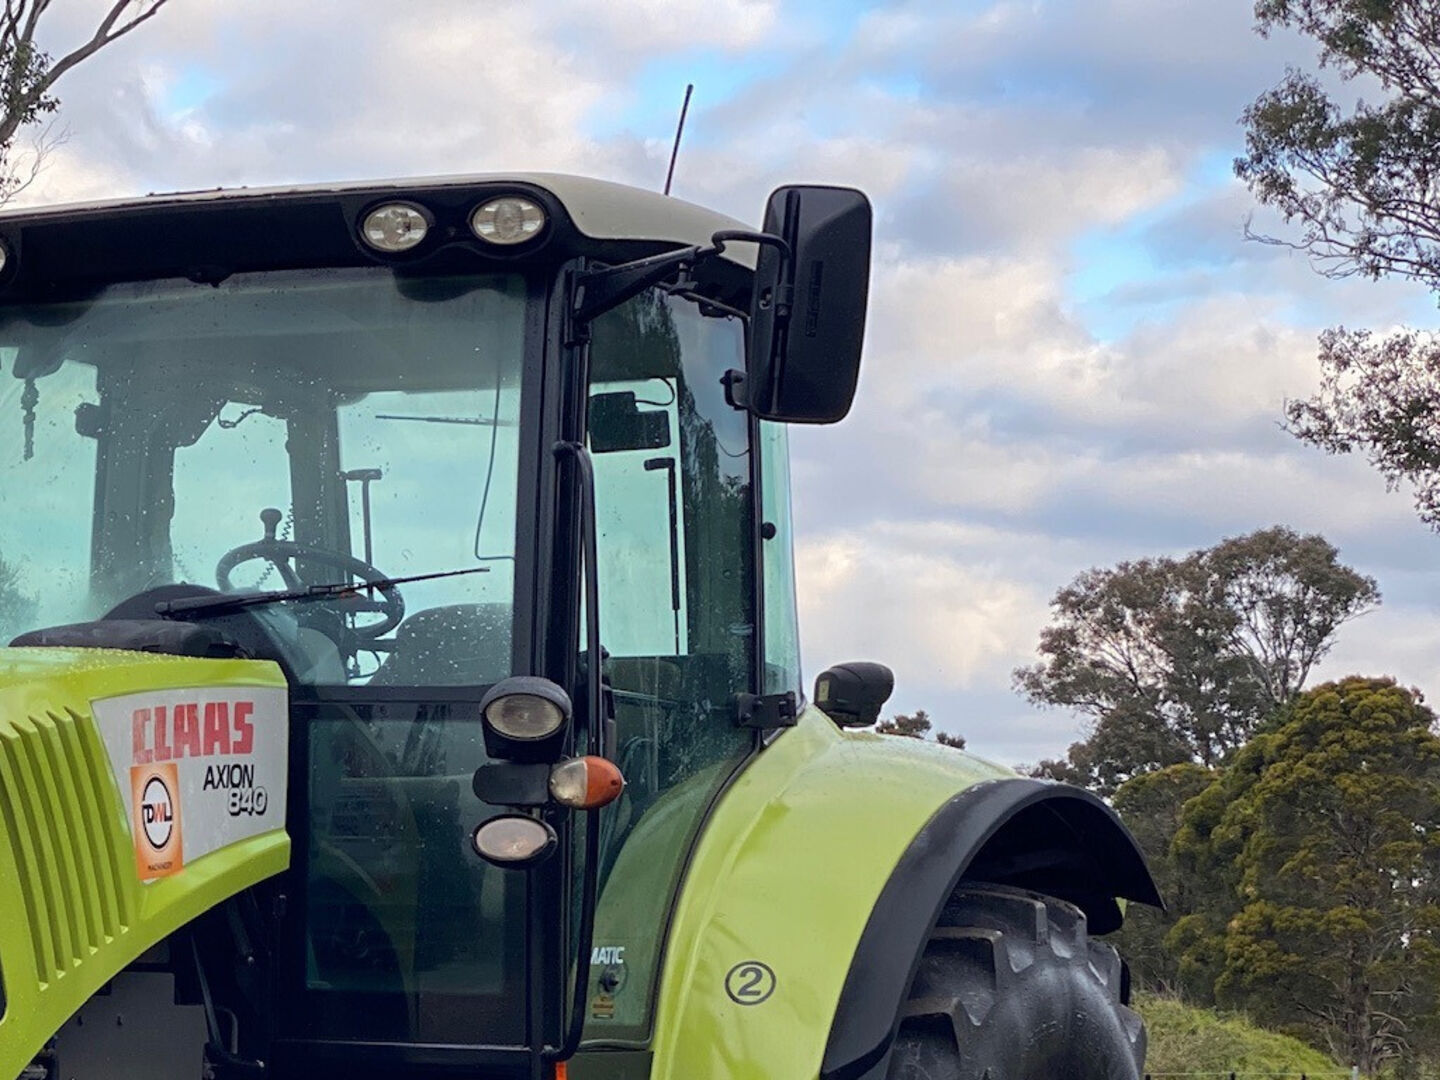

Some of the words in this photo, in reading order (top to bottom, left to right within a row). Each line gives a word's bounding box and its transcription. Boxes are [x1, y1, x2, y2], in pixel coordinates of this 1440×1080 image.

[132, 701, 254, 764] CLAAS
[203, 764, 254, 791] AXION
[227, 786, 268, 817] 840
[737, 966, 764, 997] 2
